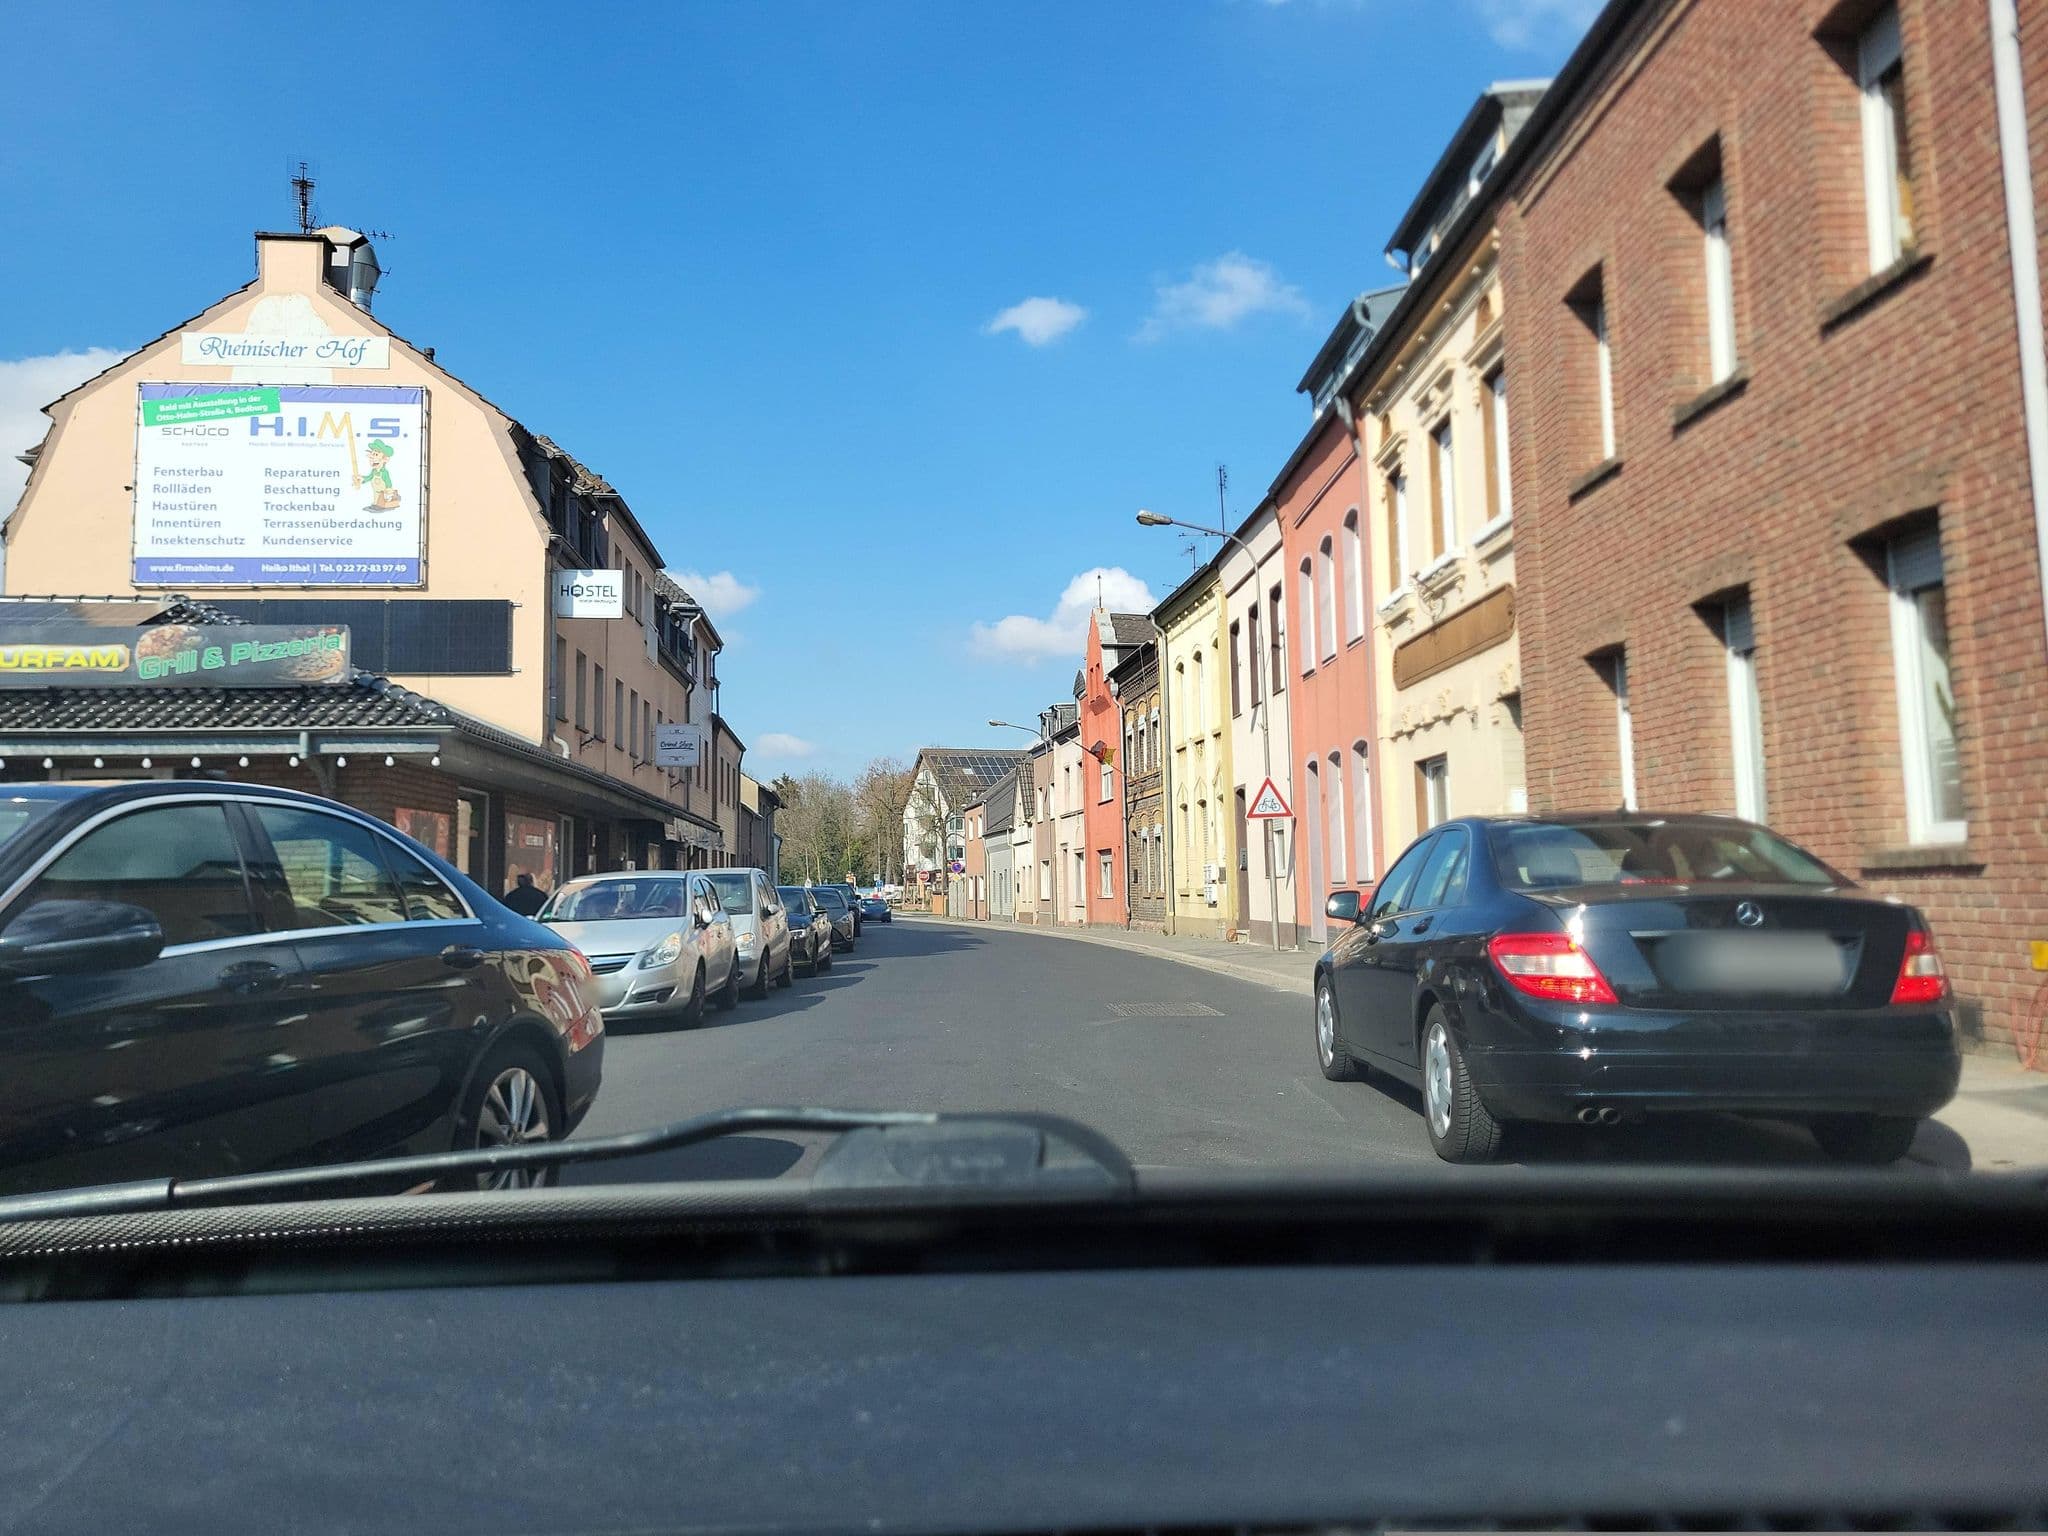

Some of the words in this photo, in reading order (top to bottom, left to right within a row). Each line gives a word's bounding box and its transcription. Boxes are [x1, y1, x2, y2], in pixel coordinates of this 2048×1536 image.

[200, 336, 308, 359] Rheinischer
[316, 338, 371, 366] Hof
[159, 403, 177, 412] Bald
[178, 401, 192, 410] mit
[193, 397, 238, 409] Ausstellung
[239, 395, 247, 404] in
[248, 395, 262, 403] der
[234, 404, 268, 415] Bedburg
[161, 424, 229, 437] SCHÜCO
[250, 411, 408, 439] H.I.M.S.
[153, 466, 224, 477] Fensterbau
[264, 467, 341, 480] Reparaturen
[153, 483, 212, 494] Rollläden
[264, 484, 341, 497] Beschattung
[152, 500, 217, 511] Haustüren
[264, 501, 335, 512] Trockenbau
[151, 518, 222, 529] Innentüren
[264, 518, 403, 531] Terrassenüberdachung
[151, 535, 246, 546] Insektenschutz
[262, 535, 353, 546] Kundenservice
[149, 563, 235, 573] www.firmahims.de
[261, 563, 288, 573] Heiko
[319, 563, 335, 573] Tel.
[336, 564, 343, 573] 0
[343, 564, 355, 573] 22
[356, 564, 381, 573] 72-83
[383, 564, 394, 573] 97
[395, 564, 407, 573] 49
[560, 584, 617, 598] HOSTEL
[138, 648, 199, 680] Grill
[202, 646, 226, 670] &
[230, 631, 341, 667] Pizzeria
